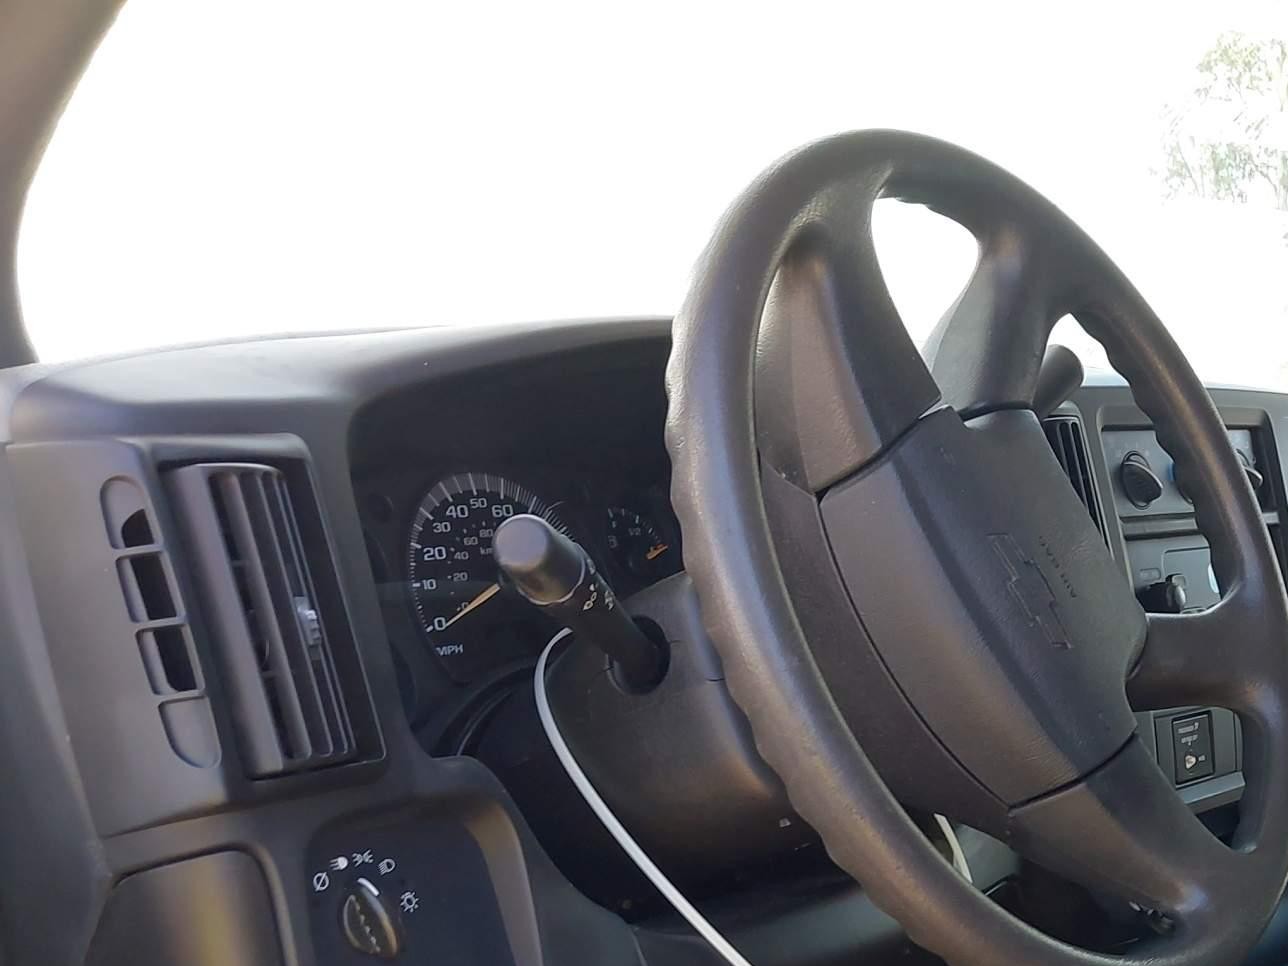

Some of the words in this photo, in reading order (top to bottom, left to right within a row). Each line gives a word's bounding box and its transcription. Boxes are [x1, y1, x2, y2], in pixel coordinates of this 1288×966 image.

[470, 497, 487, 509] 50
[445, 504, 469, 519] 40
[491, 504, 514, 518] 60
[433, 521, 451, 534] 30
[463, 537, 478, 546] 60
[423, 546, 447, 561] 20
[454, 551, 469, 560] 40
[453, 572, 468, 581] 20
[422, 578, 437, 590] 10
[433, 615, 447, 631] 0
[436, 644, 464, 656] MPH
